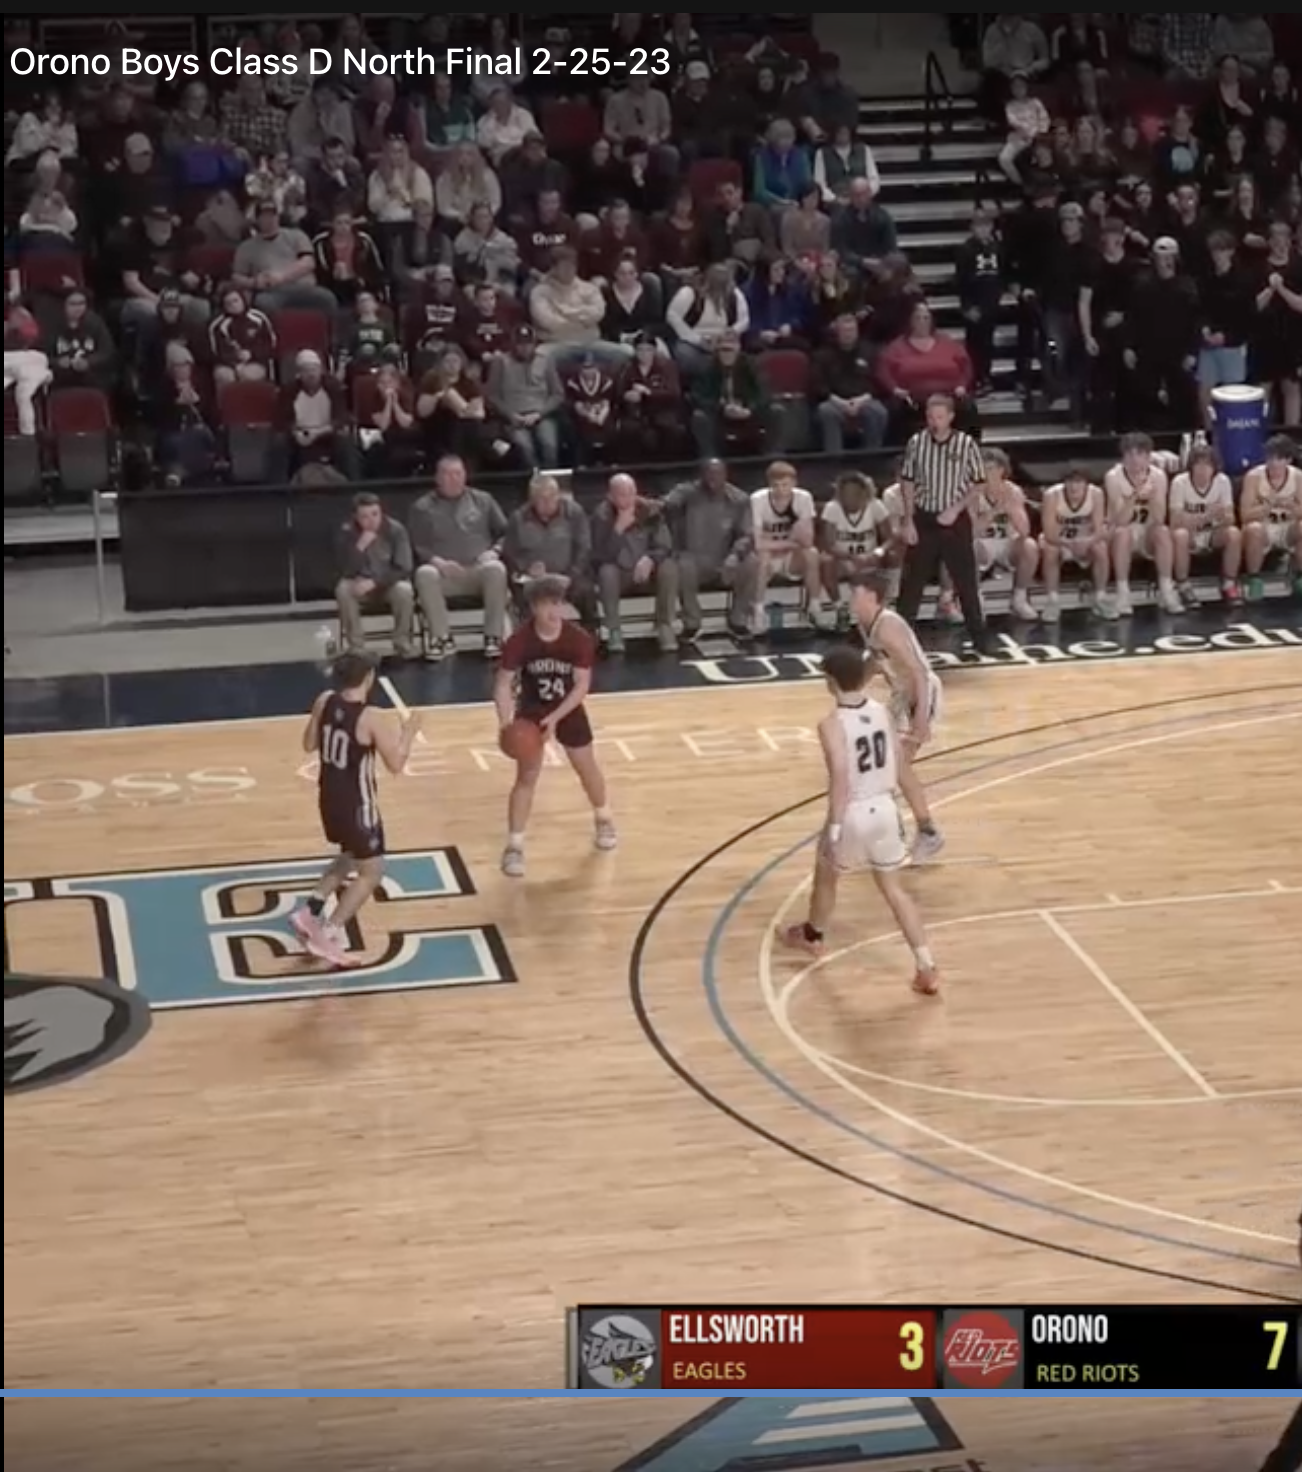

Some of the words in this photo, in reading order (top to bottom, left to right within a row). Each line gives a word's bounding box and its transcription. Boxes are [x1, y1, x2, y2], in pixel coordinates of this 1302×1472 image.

[538, 677, 566, 701] 24
[322, 724, 350, 770] 10
[855, 730, 887, 774] 20
